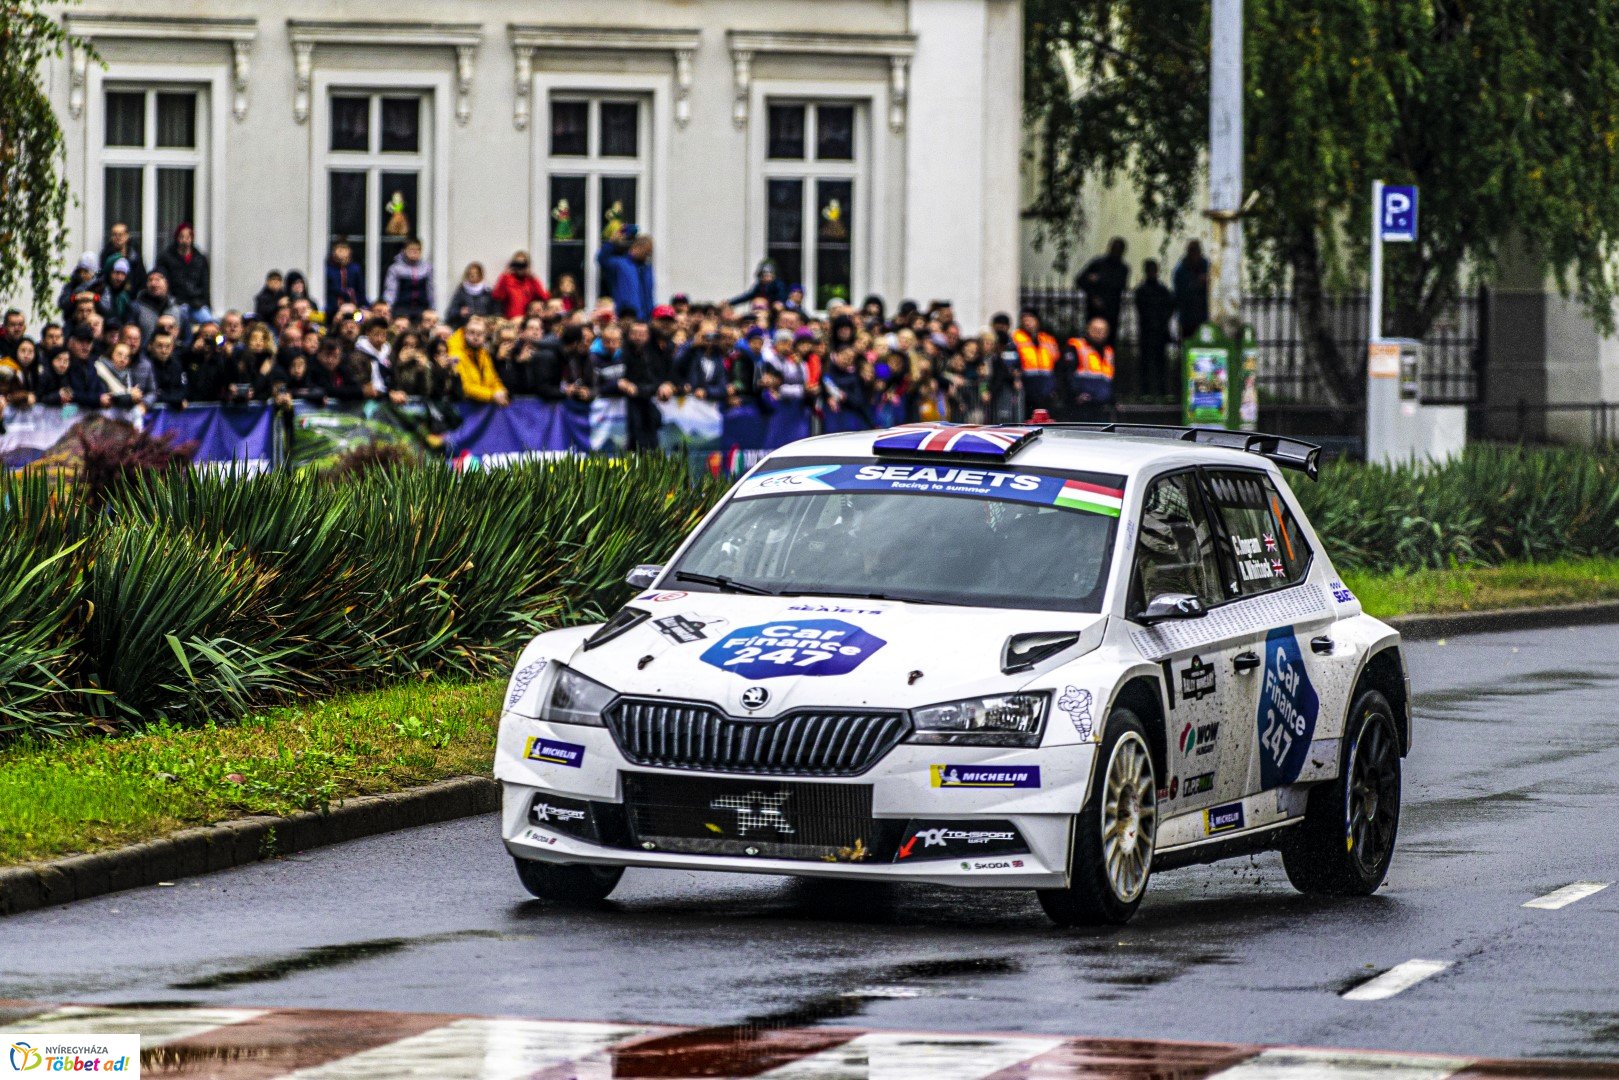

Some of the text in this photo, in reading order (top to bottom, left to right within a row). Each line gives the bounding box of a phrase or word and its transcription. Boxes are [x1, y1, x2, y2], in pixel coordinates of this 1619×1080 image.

[855, 465, 1042, 491] SEAJETS
[891, 481, 991, 494] Racing to summer
[788, 604, 883, 615] SEAJETS
[761, 625, 846, 641] Car
[722, 636, 862, 656] Finance
[723, 649, 834, 667] 247
[1276, 646, 1300, 698] Car
[1265, 668, 1306, 736] Finance
[1261, 708, 1293, 768] 247
[541, 746, 577, 760] MICHELIN
[962, 773, 1028, 781] MICHELIN
[1215, 812, 1239, 825] MICHELIN
[974, 862, 1010, 870] ŠKODA
